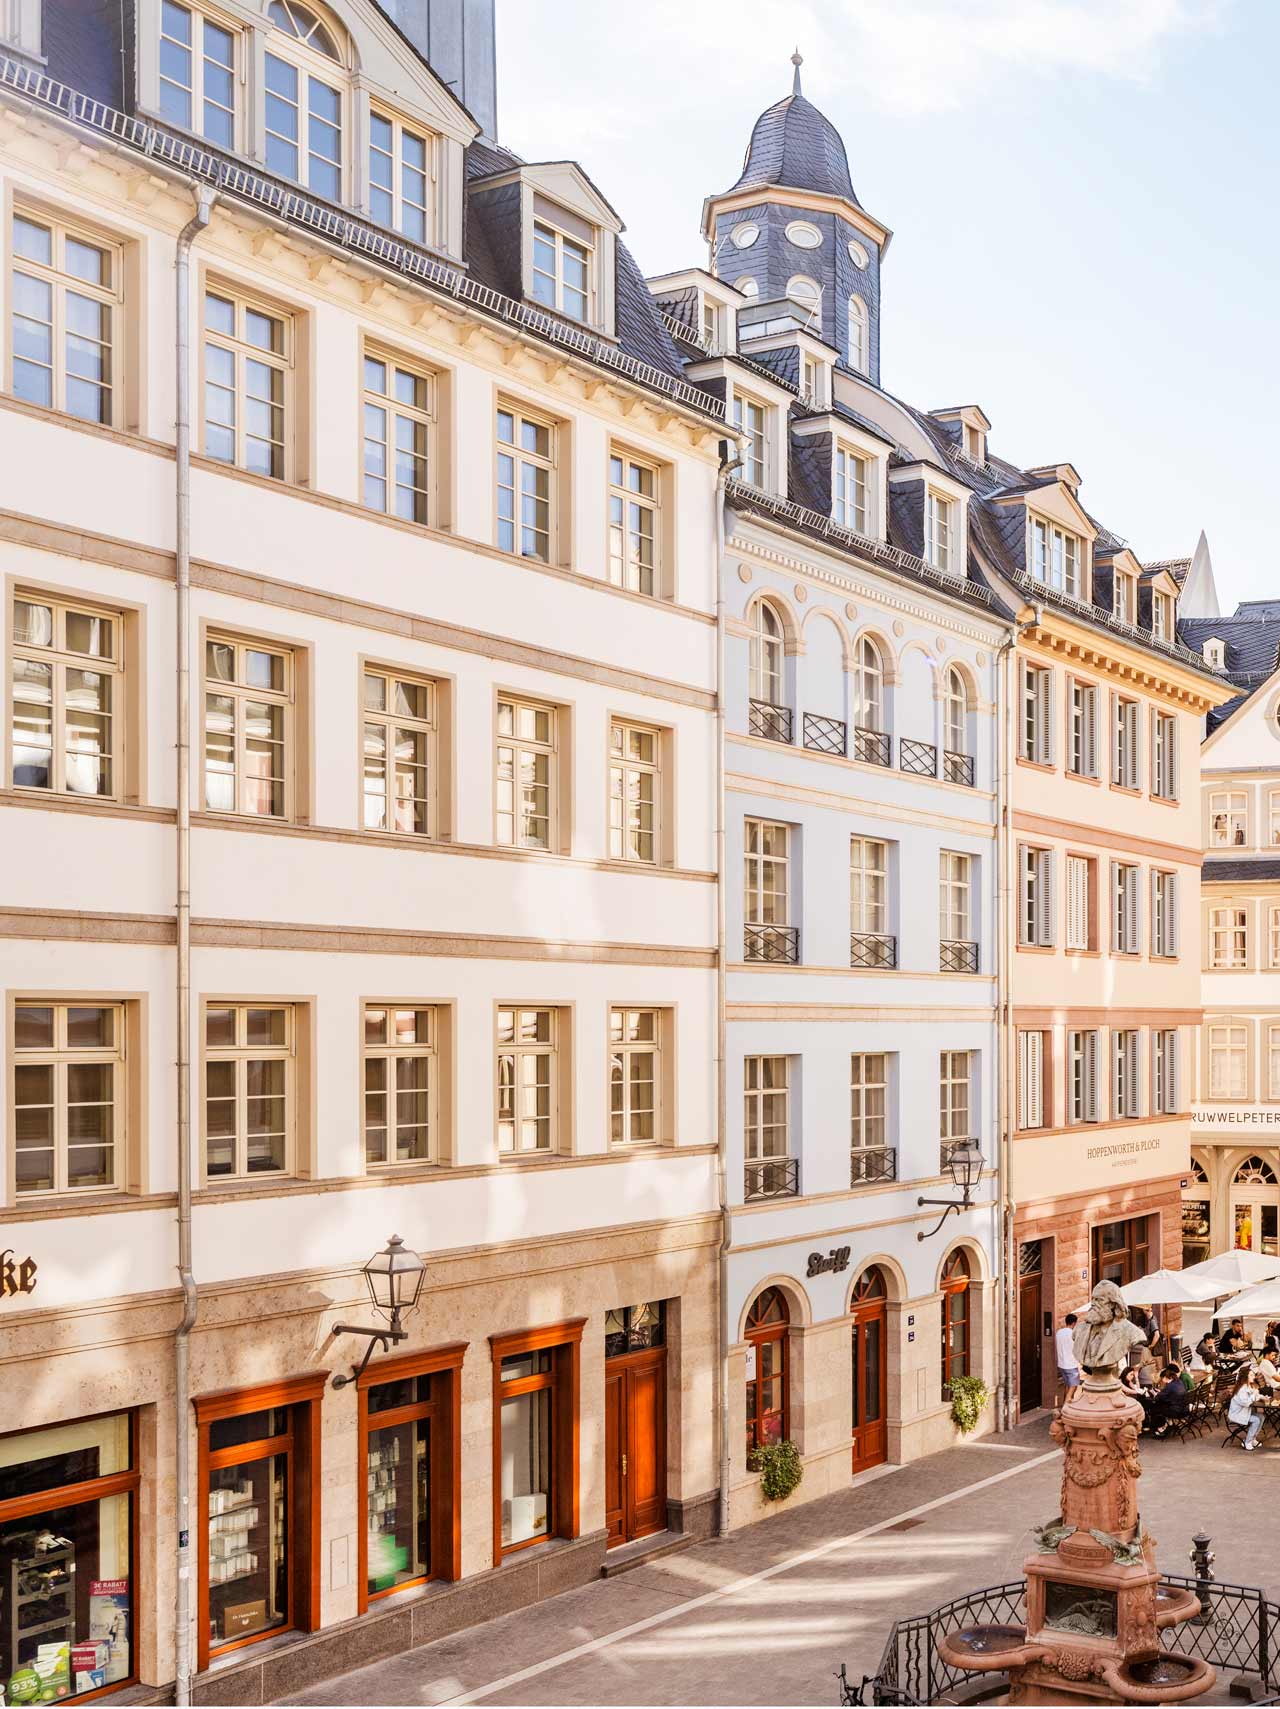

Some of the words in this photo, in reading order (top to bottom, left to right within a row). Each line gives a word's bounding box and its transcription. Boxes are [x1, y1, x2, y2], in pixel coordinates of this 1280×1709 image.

[1087, 1142, 1135, 1159] HOPPENWORTH
[1140, 1139, 1160, 1151] PLOCH
[11, 1678, 38, 1693] 93%
